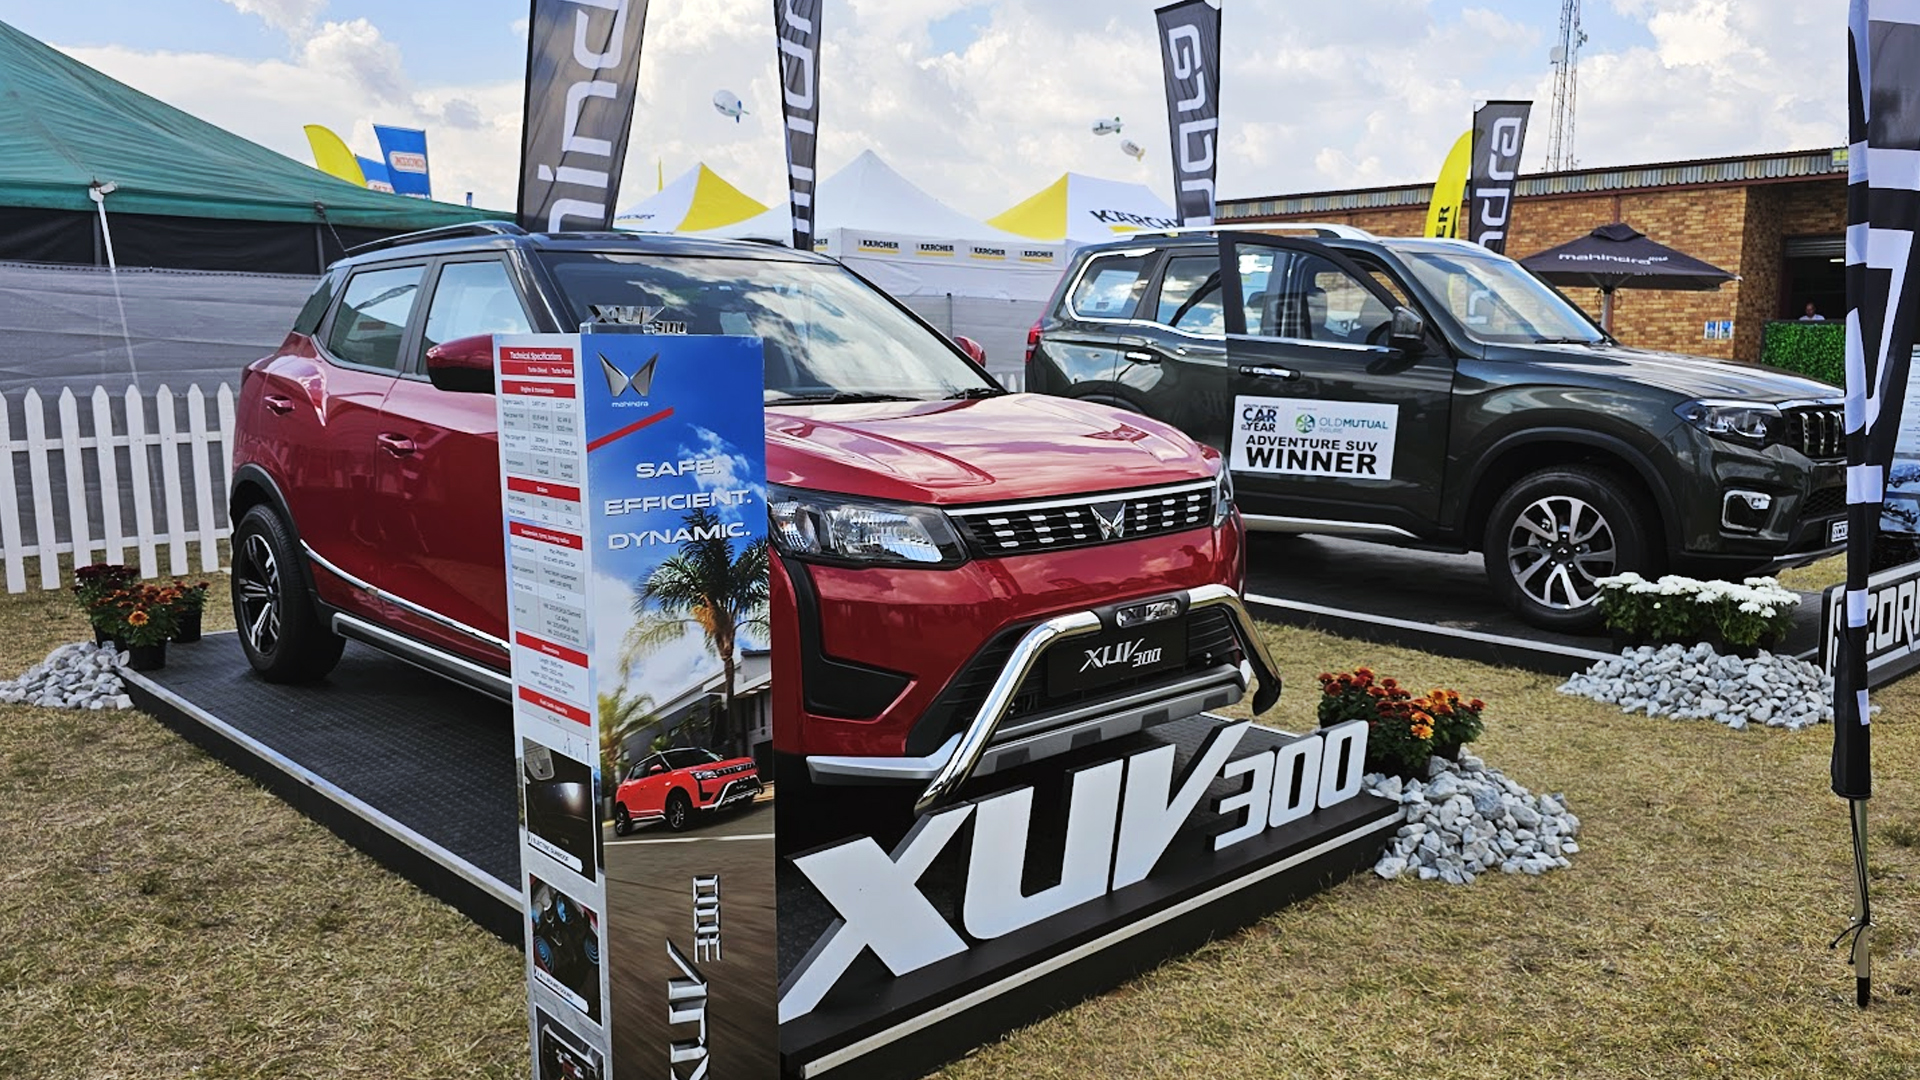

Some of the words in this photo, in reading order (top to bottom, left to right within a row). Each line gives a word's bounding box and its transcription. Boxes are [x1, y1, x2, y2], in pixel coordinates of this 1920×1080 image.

[1558, 253, 1651, 265] mahindra
[510, 351, 530, 359] Technical
[531, 352, 562, 361] Specifications
[612, 400, 649, 408] mahindra
[1242, 407, 1277, 423] CAR
[1246, 421, 1276, 433] YEAR
[1246, 434, 1341, 450] ADVENTURE
[1345, 440, 1378, 452] SUV
[636, 459, 721, 479] SAFE.
[1246, 446, 1377, 475] WINNER
[604, 489, 752, 516] EFFICIENT.
[608, 522, 751, 551] DYNAMIC.
